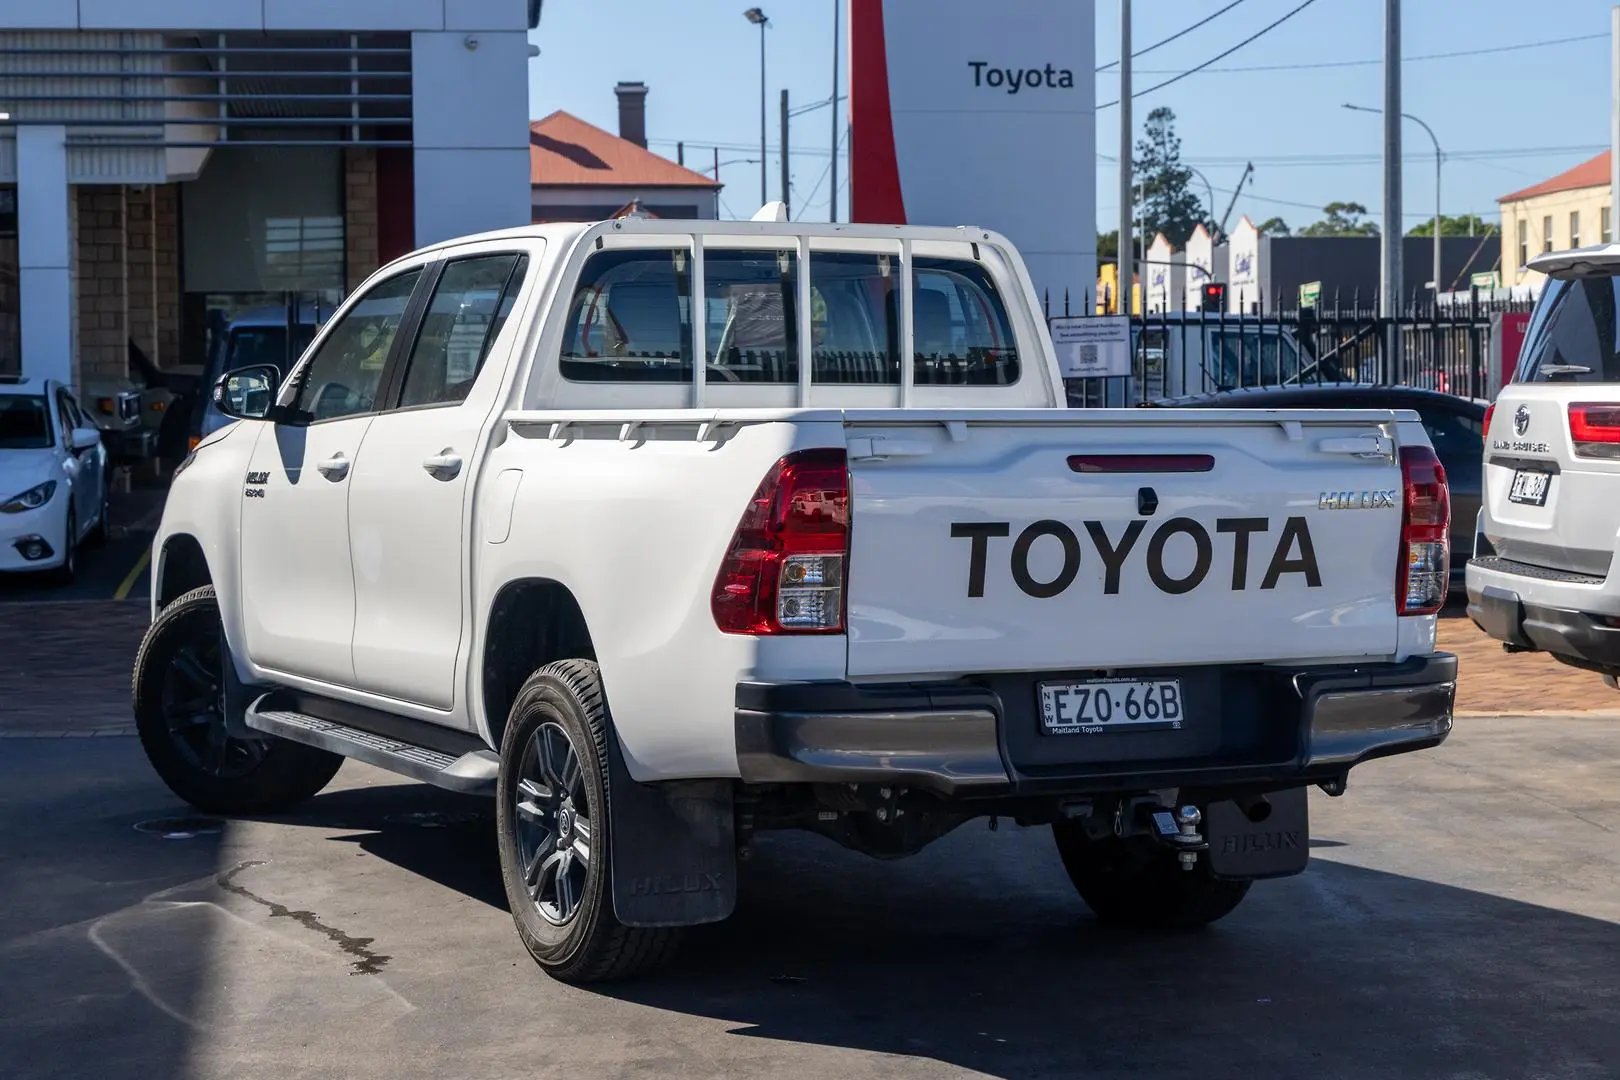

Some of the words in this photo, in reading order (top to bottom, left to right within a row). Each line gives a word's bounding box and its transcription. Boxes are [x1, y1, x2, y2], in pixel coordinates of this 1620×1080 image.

[968, 62, 1074, 94] Toyota
[1318, 489, 1396, 510] HILUX
[950, 516, 1322, 598] TOYOTA
[1081, 726, 1104, 735] Toyota
